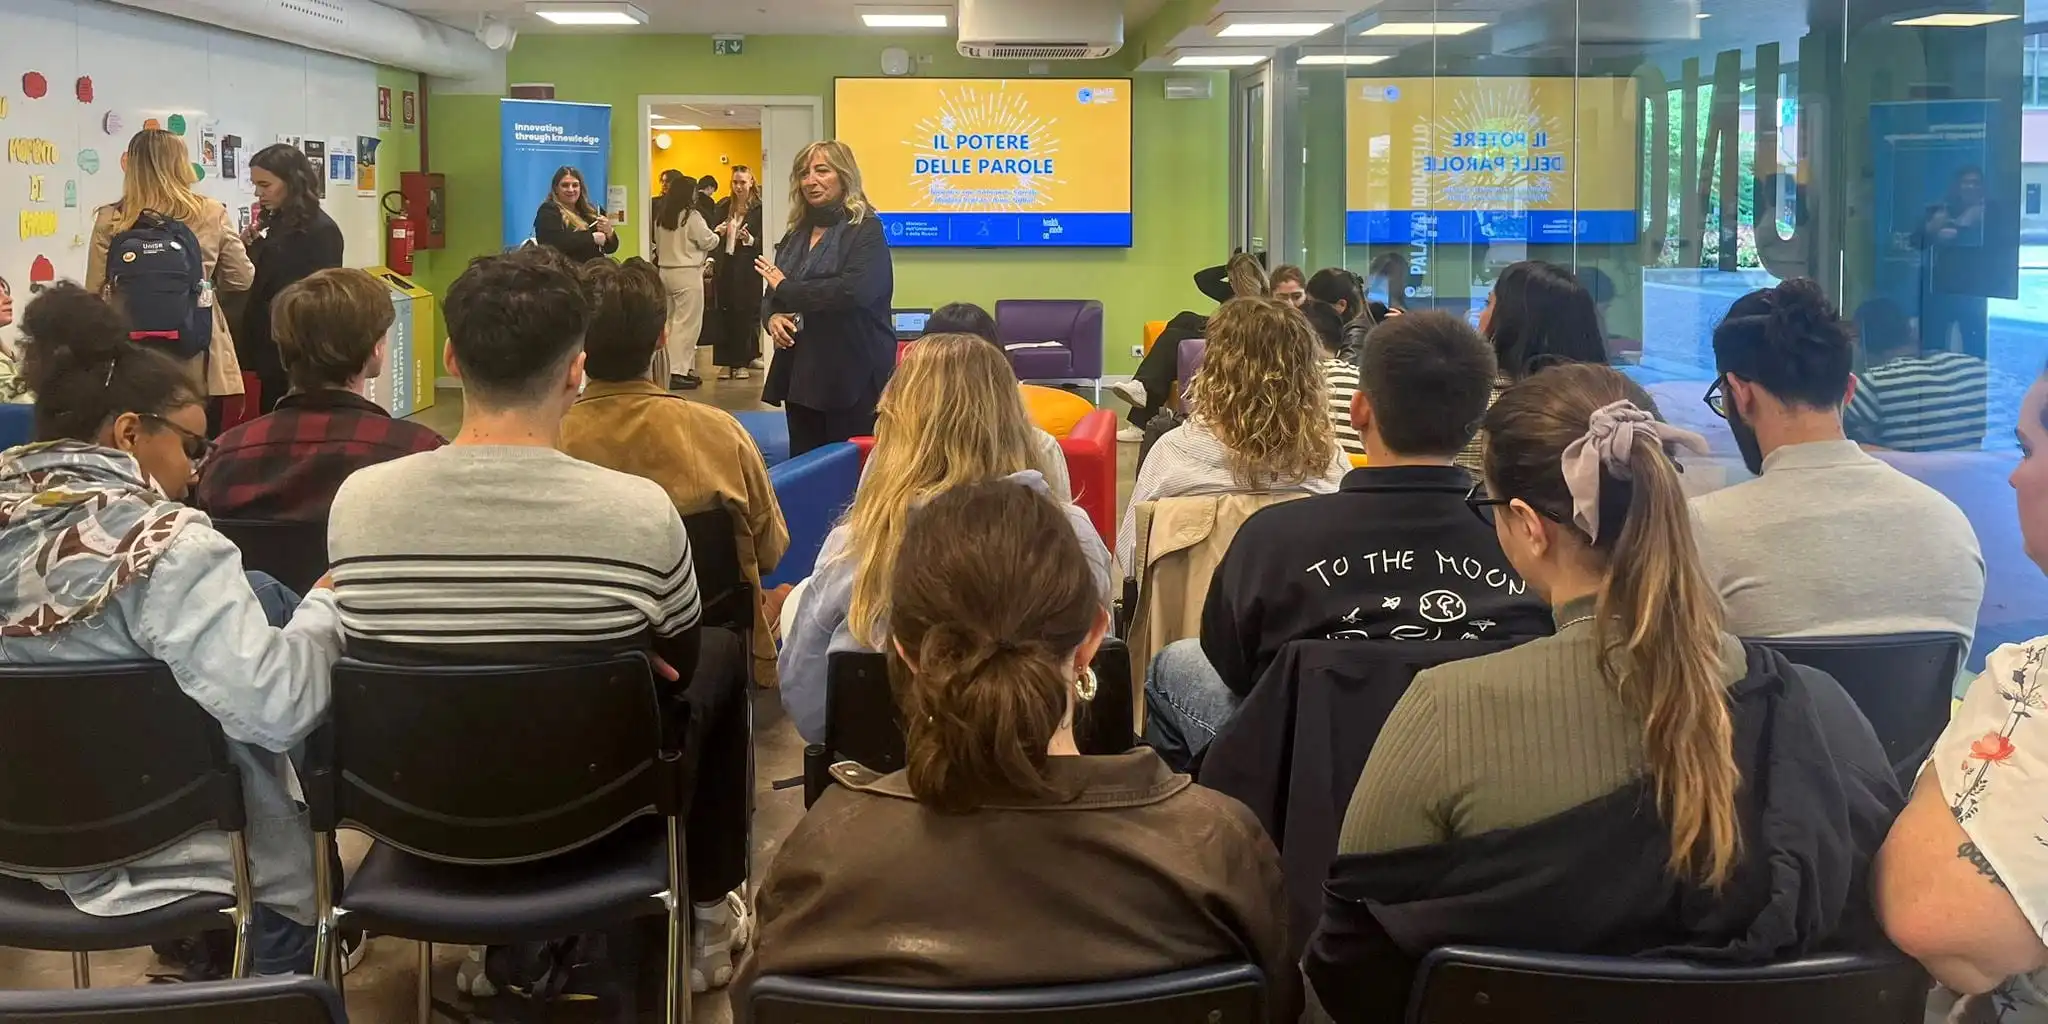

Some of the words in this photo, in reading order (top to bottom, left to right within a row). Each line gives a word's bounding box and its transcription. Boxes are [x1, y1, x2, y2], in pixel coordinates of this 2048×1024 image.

[515, 123, 563, 134] Innovating
[515, 133, 551, 143] through
[552, 134, 600, 145] knowledge
[933, 134, 949, 150] IL
[956, 134, 1029, 150] POTERE
[915, 158, 971, 174] DELLE
[978, 158, 1054, 174] PAROLE
[1411, 124, 1429, 206] DONATELLO
[1410, 211, 1427, 275] PALAZZO
[1306, 556, 1350, 587] TO
[1363, 549, 1415, 574] THE
[1434, 549, 1527, 596] MOON
